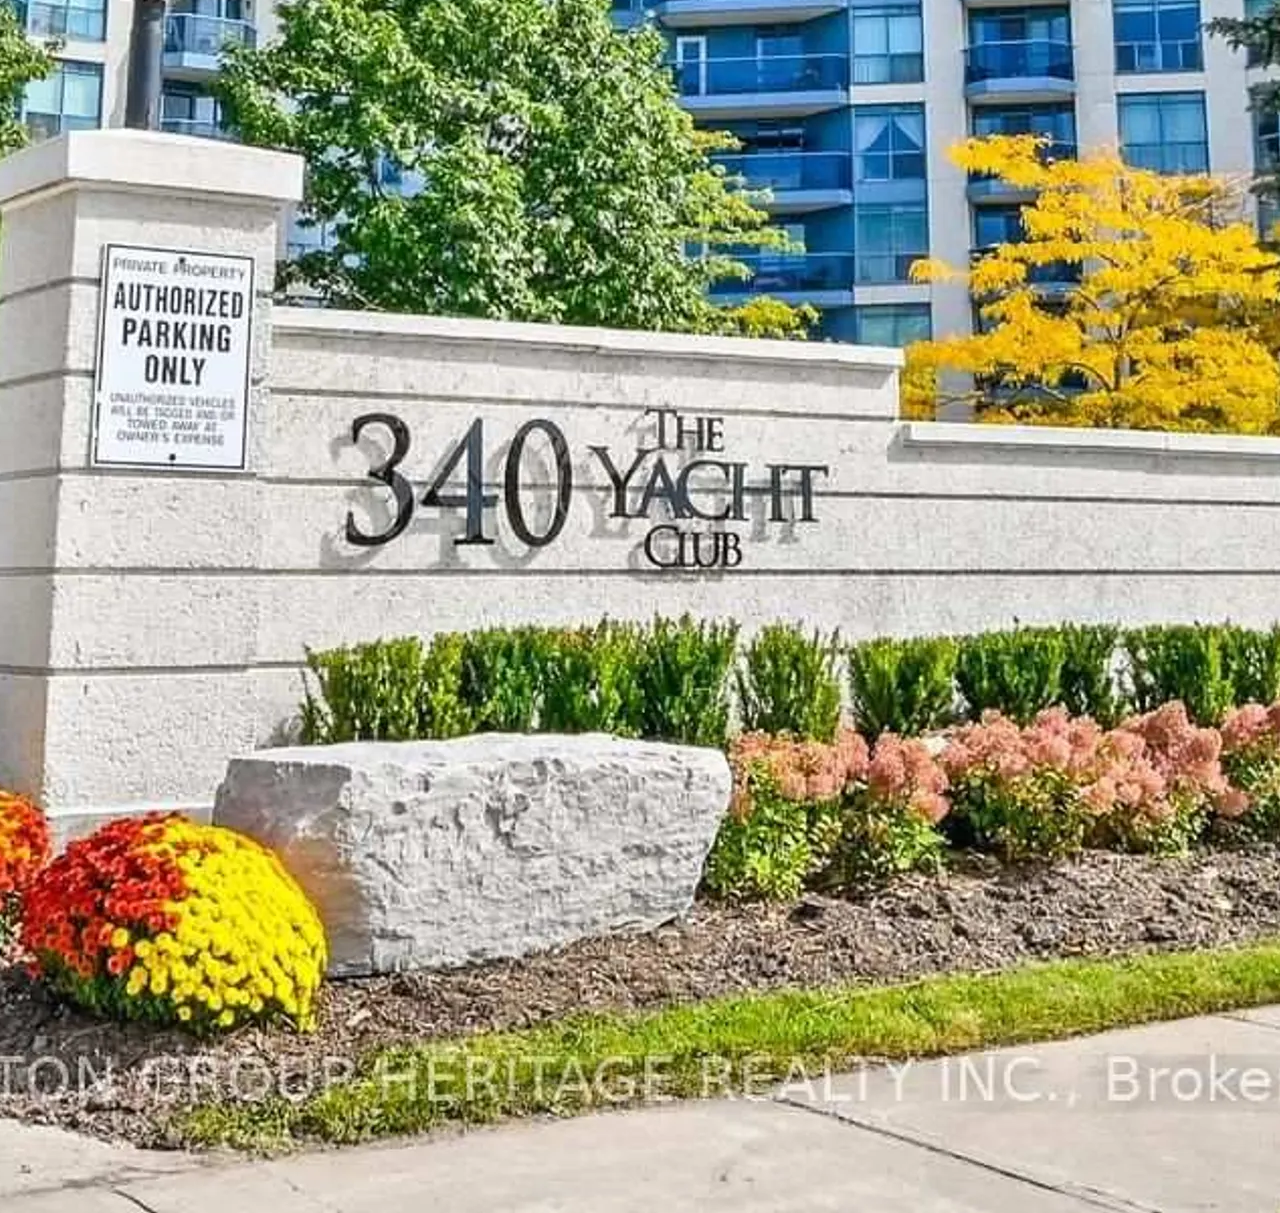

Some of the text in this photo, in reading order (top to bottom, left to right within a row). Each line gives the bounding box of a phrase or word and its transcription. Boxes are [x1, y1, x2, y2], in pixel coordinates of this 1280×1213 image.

[114, 257, 245, 279] PRIVATE PROPERTY
[114, 282, 243, 319] AUTHORIZED
[122, 318, 231, 353] PARKING
[145, 354, 206, 386] ONLY
[645, 408, 725, 453] THE
[346, 412, 573, 548] 340
[589, 445, 830, 523] YACHT
[644, 524, 743, 568] CLUB
